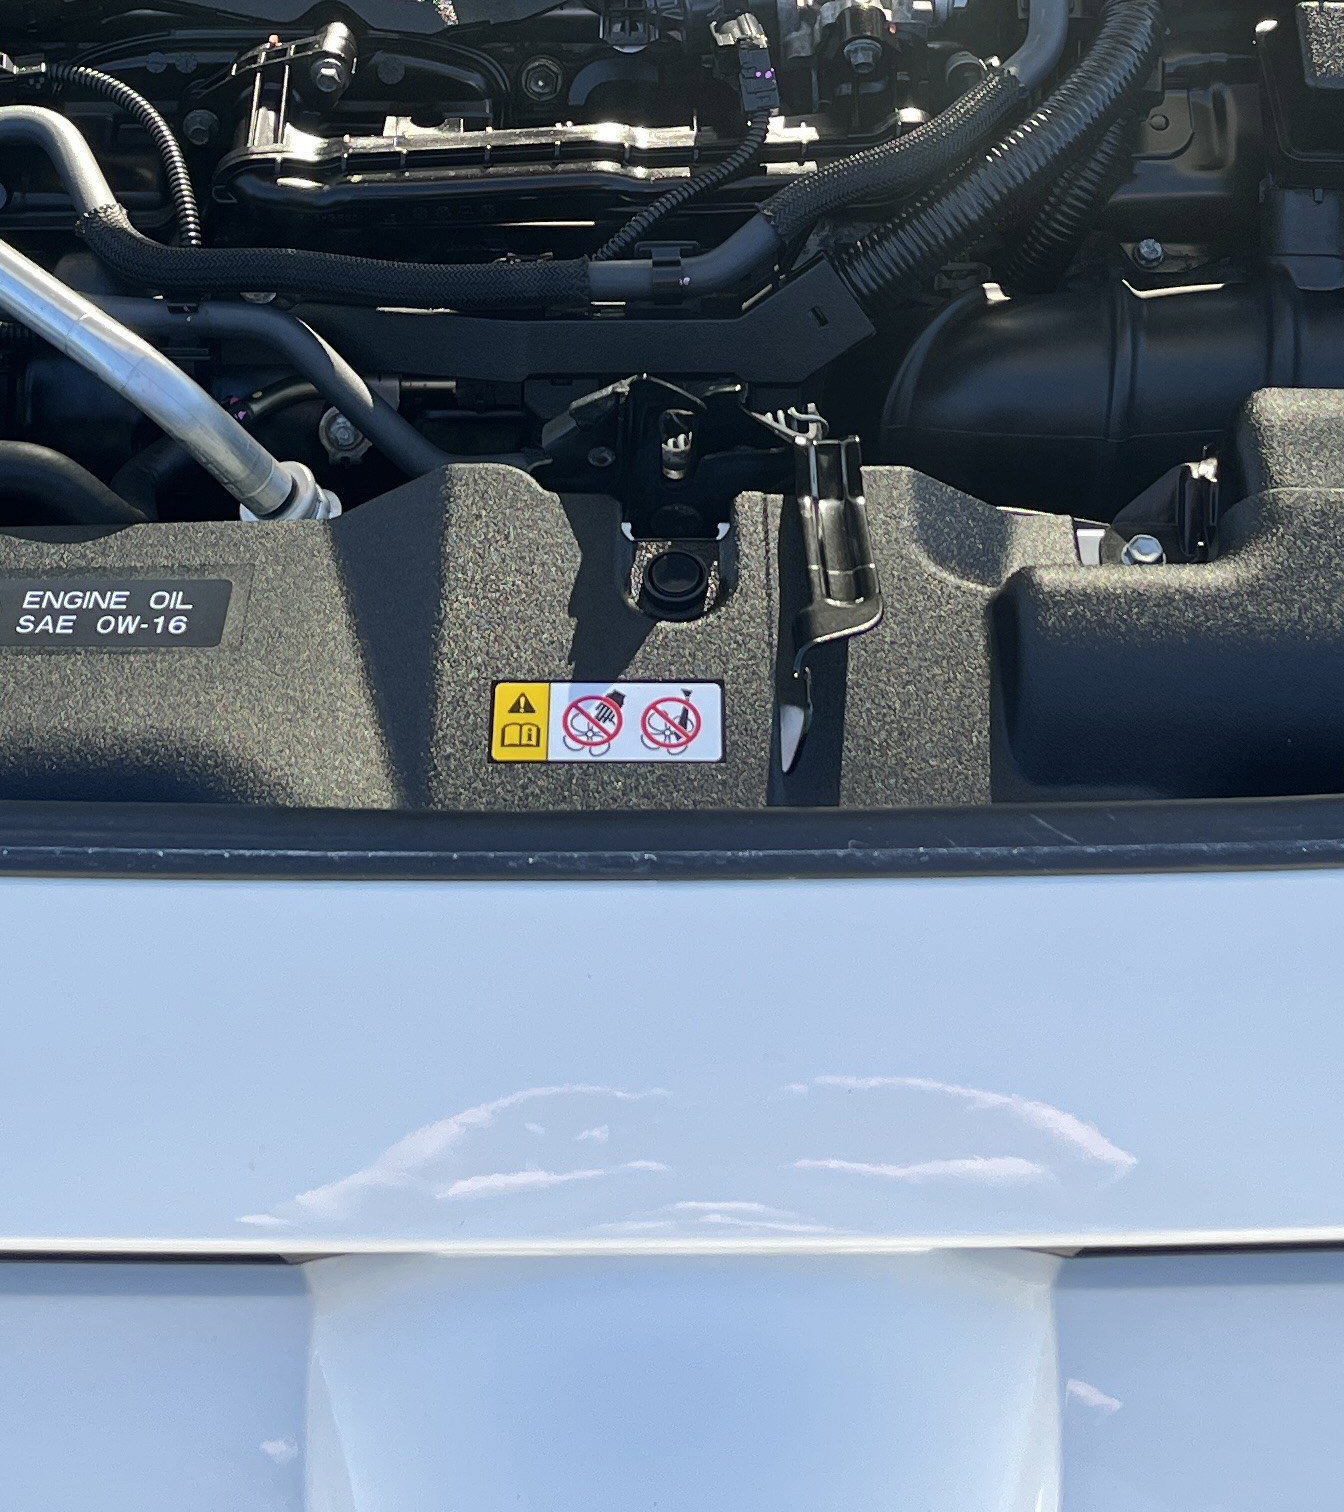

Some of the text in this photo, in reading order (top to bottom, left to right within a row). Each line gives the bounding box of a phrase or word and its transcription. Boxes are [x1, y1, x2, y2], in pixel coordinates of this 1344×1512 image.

[22, 590, 194, 610] ENGINE OIL
[15, 614, 188, 635] SAE 0W-16
